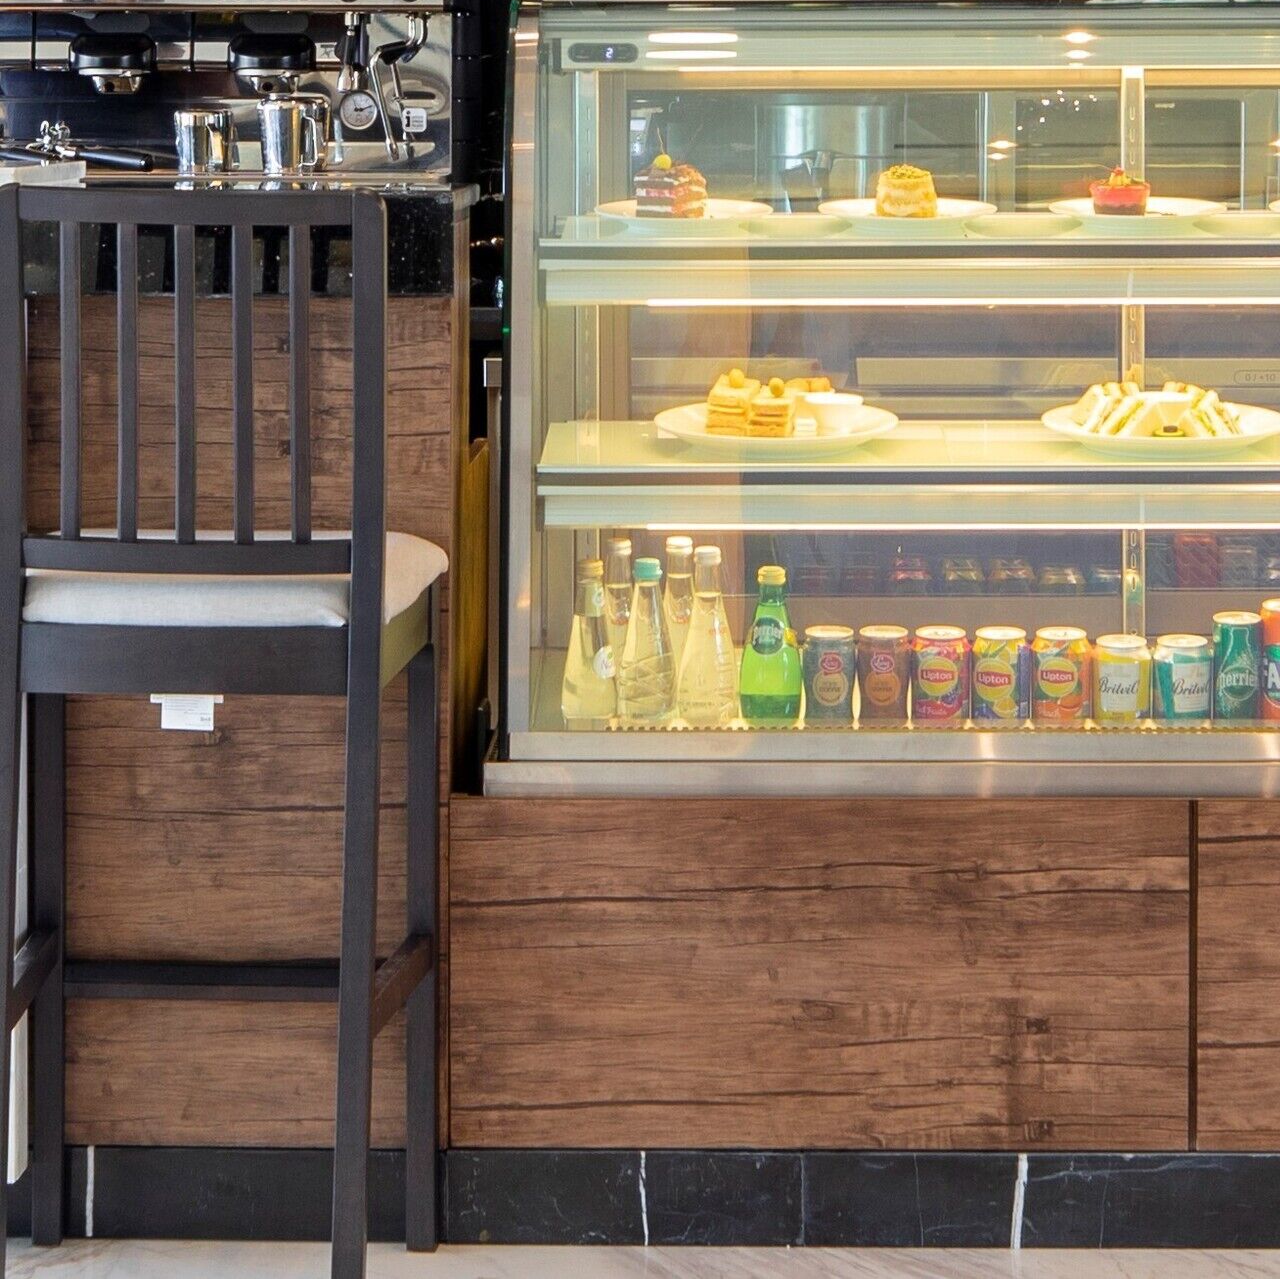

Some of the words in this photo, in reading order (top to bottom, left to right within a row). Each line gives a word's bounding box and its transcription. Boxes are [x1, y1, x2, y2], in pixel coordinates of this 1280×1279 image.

[922, 668, 953, 683] Lipton
[978, 672, 1009, 685] Lipton
[1043, 668, 1073, 682] Lipton
